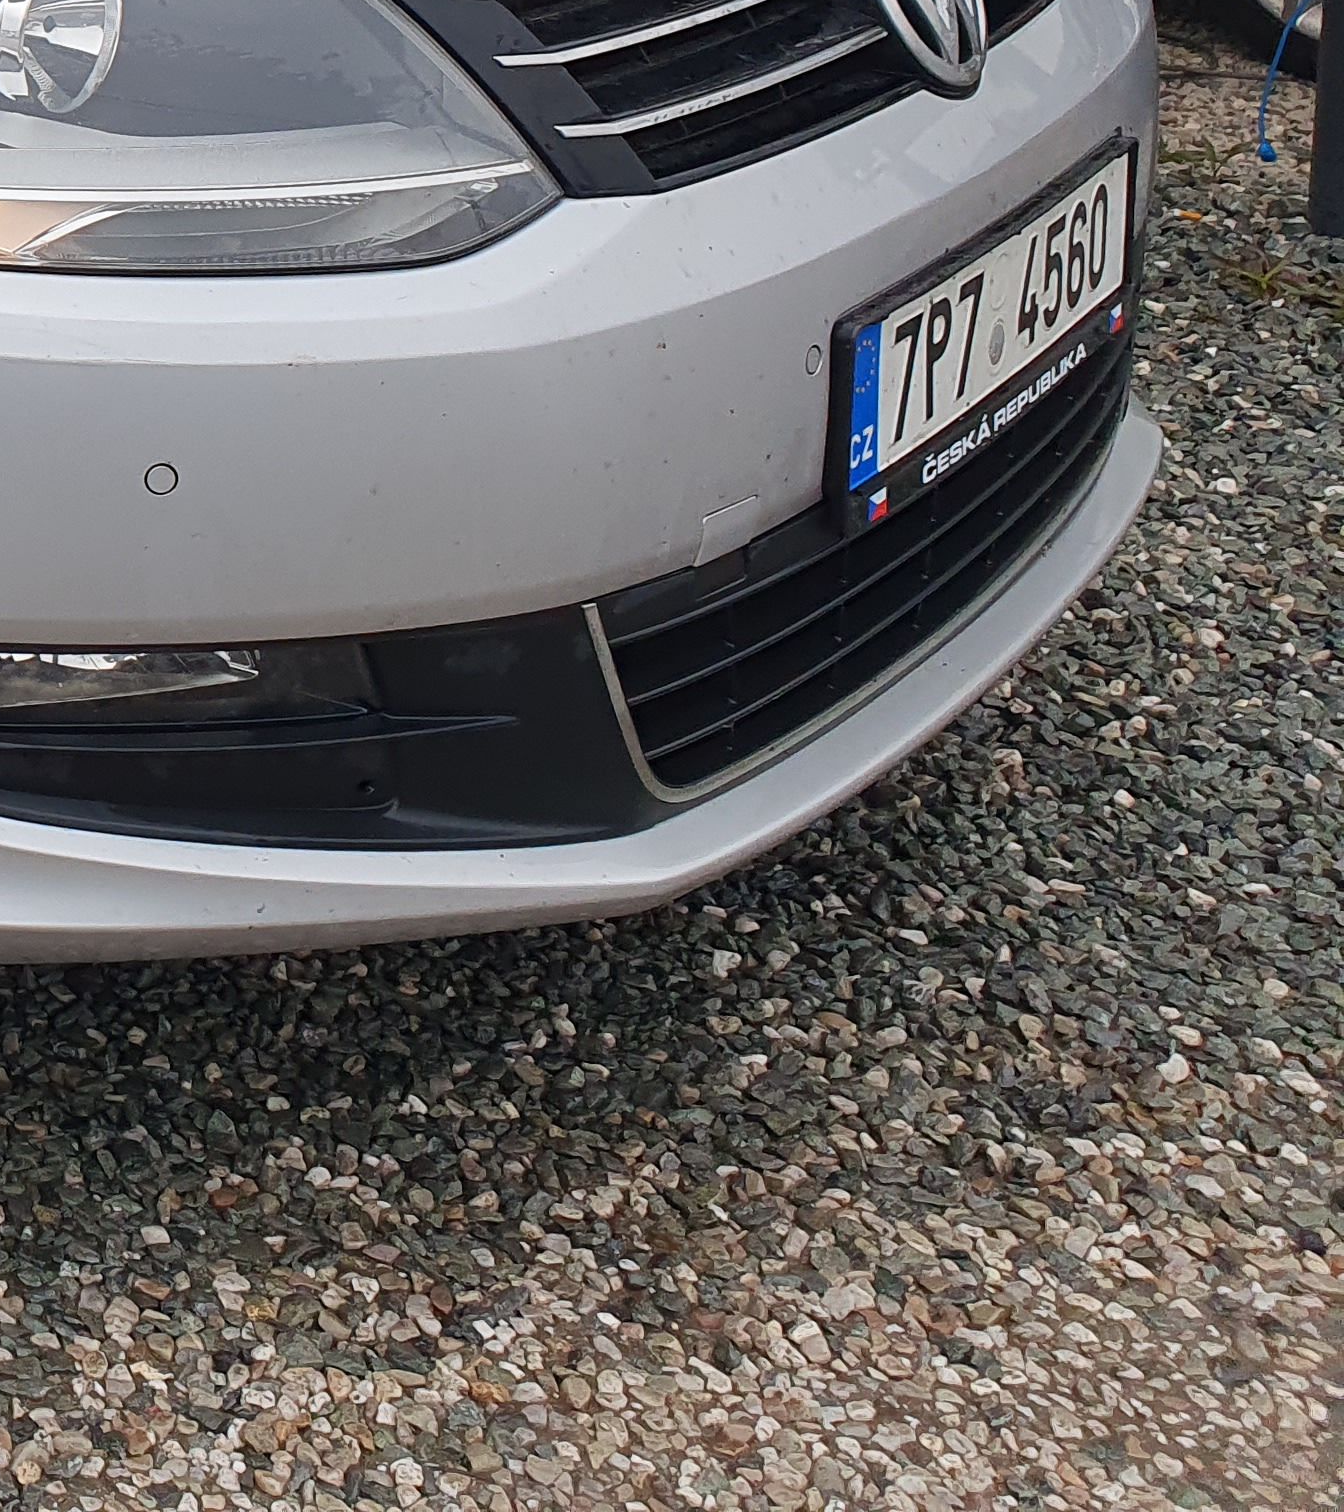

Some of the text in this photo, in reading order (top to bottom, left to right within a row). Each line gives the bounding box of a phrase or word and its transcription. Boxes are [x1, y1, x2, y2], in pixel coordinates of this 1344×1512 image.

[890, 184, 1108, 445] 7P7 4560
[849, 426, 874, 470] CZ
[921, 343, 1088, 486] ČESKÁ REPUBLIKA
